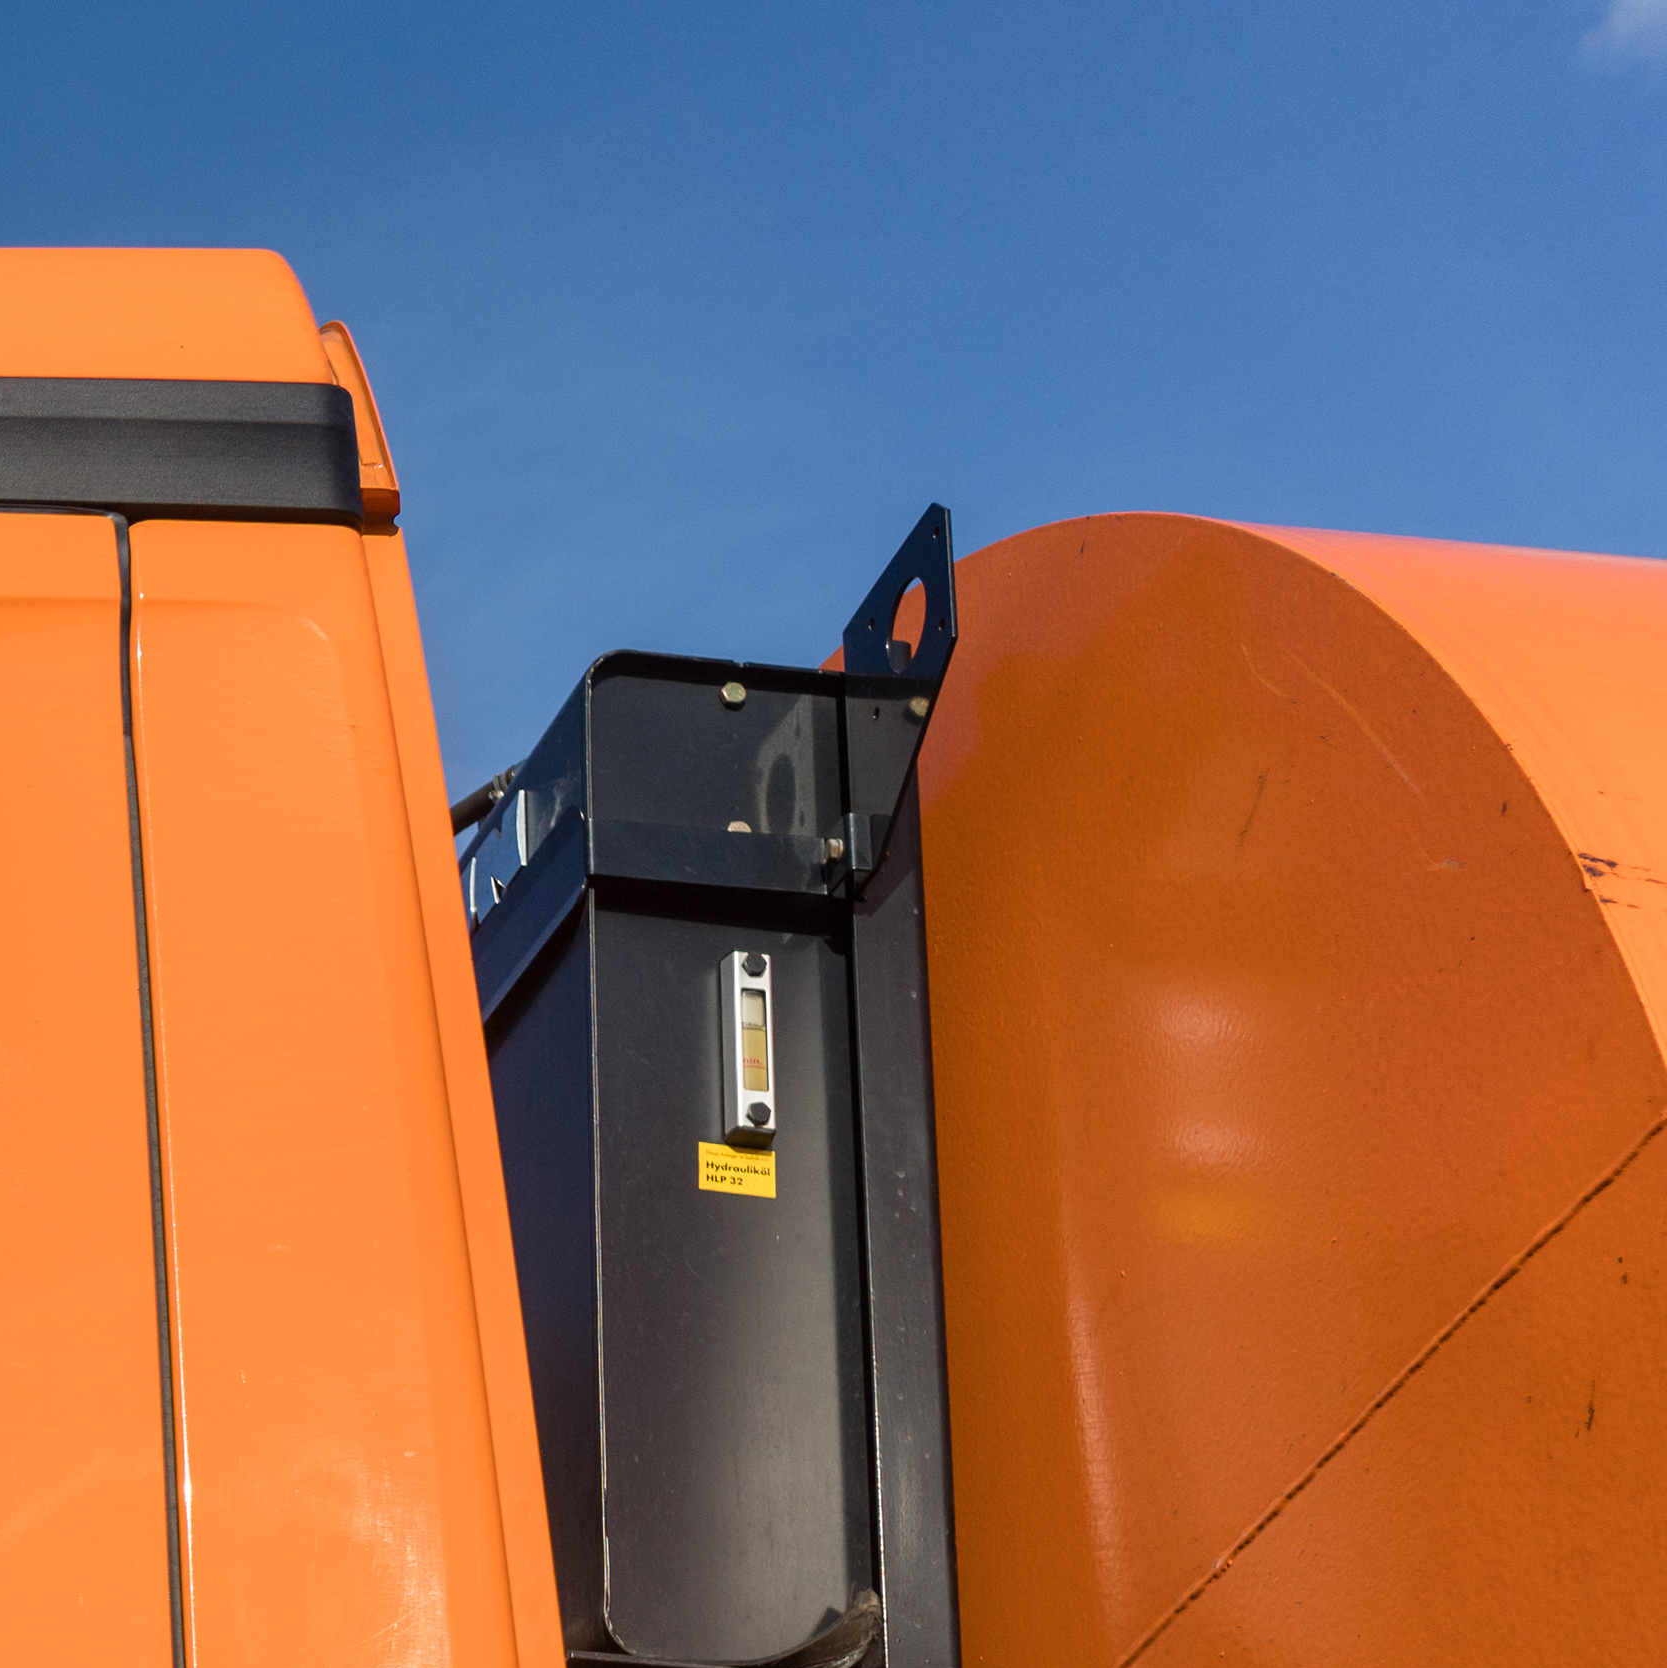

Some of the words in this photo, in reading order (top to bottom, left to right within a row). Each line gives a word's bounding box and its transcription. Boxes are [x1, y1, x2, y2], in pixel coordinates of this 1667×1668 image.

[706, 1161, 771, 1176] Hydrauliköl
[706, 1174, 727, 1183] HLP
[730, 1177, 743, 1185] 32
